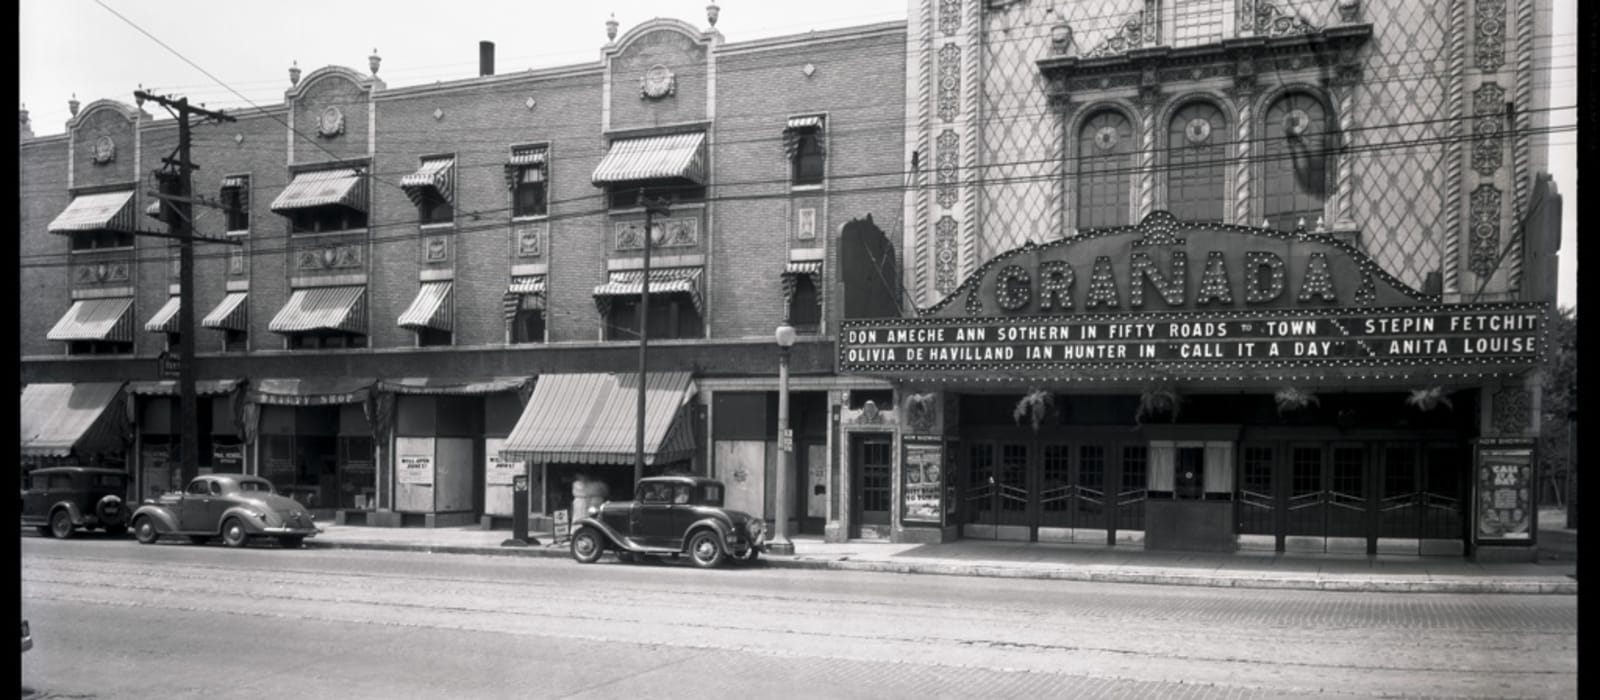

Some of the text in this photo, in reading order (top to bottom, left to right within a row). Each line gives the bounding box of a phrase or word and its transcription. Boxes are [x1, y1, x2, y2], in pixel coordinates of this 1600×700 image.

[996, 251, 1336, 309] GRANADA
[849, 330, 877, 344] DON
[887, 328, 945, 343] AMECHE
[956, 327, 986, 341] ANN
[997, 325, 1069, 341] SOTHERN
[1080, 325, 1097, 340] IN
[1109, 323, 1155, 339] FIFTY
[1169, 322, 1227, 338] ROADS
[1240, 323, 1253, 332] TO
[1266, 320, 1317, 336] TOWN
[1365, 317, 1435, 334] STEPIN
[1450, 314, 1536, 332] FETCHIT
[848, 347, 896, 362] OLIVIA
[906, 347, 924, 361] DE
[929, 345, 1014, 361] HAVILLAND
[1026, 345, 1053, 360] IAN
[1064, 344, 1127, 360] HUNTER
[1139, 344, 1156, 358] IN
[1168, 343, 1224, 359] "CALL
[1238, 342, 1255, 357] IT
[1268, 341, 1280, 357] A
[1294, 340, 1346, 356] DAY"
[1389, 339, 1448, 354] ANITA
[1464, 337, 1535, 353] LOUISE
[319, 393, 354, 404] SHOP
[1491, 465, 1518, 473] CALL
